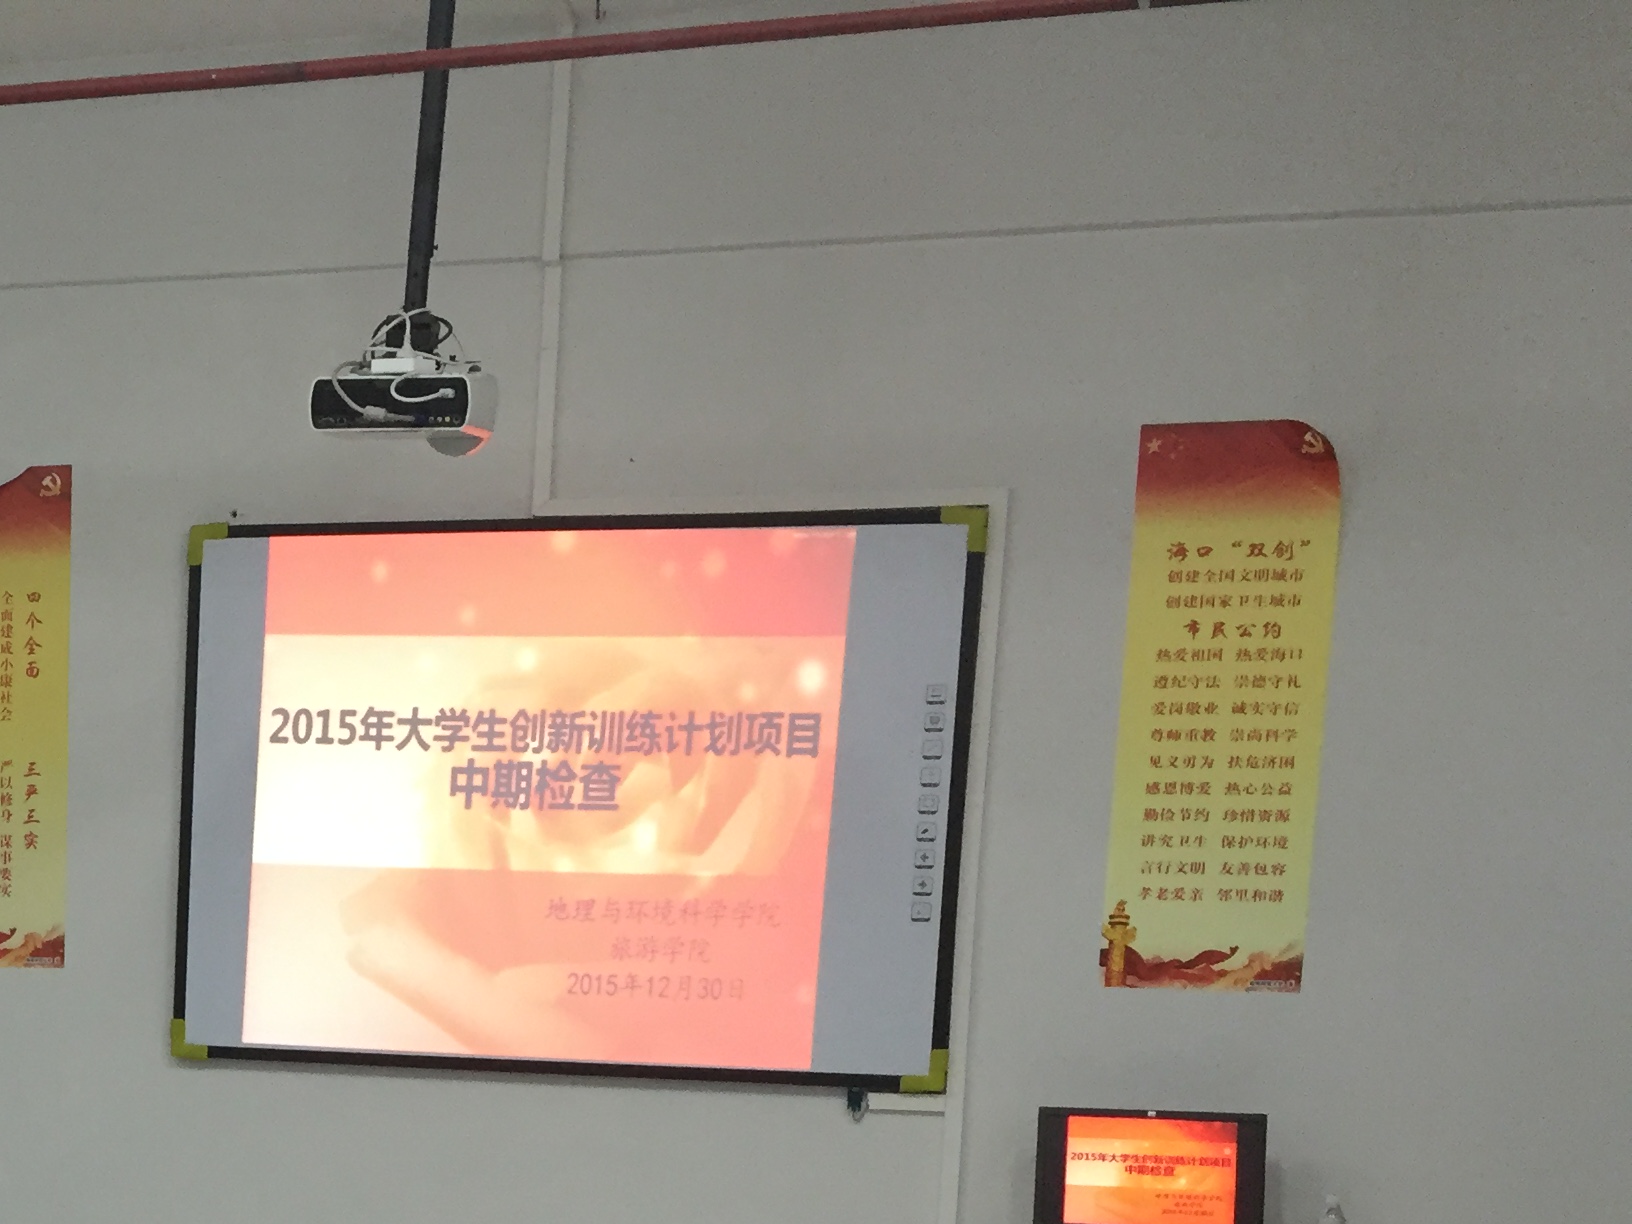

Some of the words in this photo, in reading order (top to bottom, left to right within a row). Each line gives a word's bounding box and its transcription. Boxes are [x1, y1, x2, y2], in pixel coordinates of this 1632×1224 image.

[1168, 568, 1305, 583] 创建全国文明城市
[1165, 594, 1302, 608] 创建国家卫生城市
[24, 591, 43, 679] 四个全面
[1183, 619, 1282, 640] 市民公约
[0, 590, 14, 721] 全面建成小康社会
[1155, 647, 1224, 662] 热爱祖国
[1234, 647, 1303, 662] 热爱海口
[1153, 674, 1221, 689] 遵纪守法
[1233, 674, 1302, 689] 崇德守礼
[1151, 701, 1220, 716] 爱岗敬业
[1231, 701, 1300, 716] 诚实守信
[268, 706, 822, 758] 2015年大学生创新训练计划项目
[1150, 728, 1217, 742] 尊师重教
[1229, 728, 1299, 742] 崇尚科学
[1149, 755, 1215, 769] 见义勇为
[1227, 754, 1296, 769] 扶危济困
[0, 760, 14, 823] 严以修身
[449, 758, 622, 812] 中期检查
[1145, 781, 1212, 796] 感恩博爱
[1224, 781, 1292, 796] 热心公益
[22, 761, 41, 850] 三严三实
[1143, 807, 1210, 822] 勤俭节约
[1222, 807, 1291, 823] 珍惜资源
[1141, 834, 1207, 849] 讲究卫生
[1221, 834, 1289, 850] 保护环境
[0, 834, 13, 898] 谋事要实
[1140, 860, 1206, 875] 言行文明
[1220, 861, 1287, 876] 友善包容
[1138, 886, 1203, 902] 孝老爱亲
[1216, 887, 1285, 904] 邻里和谐
[545, 896, 781, 928] 地理与环境科学学院
[567, 972, 745, 1001] 2015年12月30日
